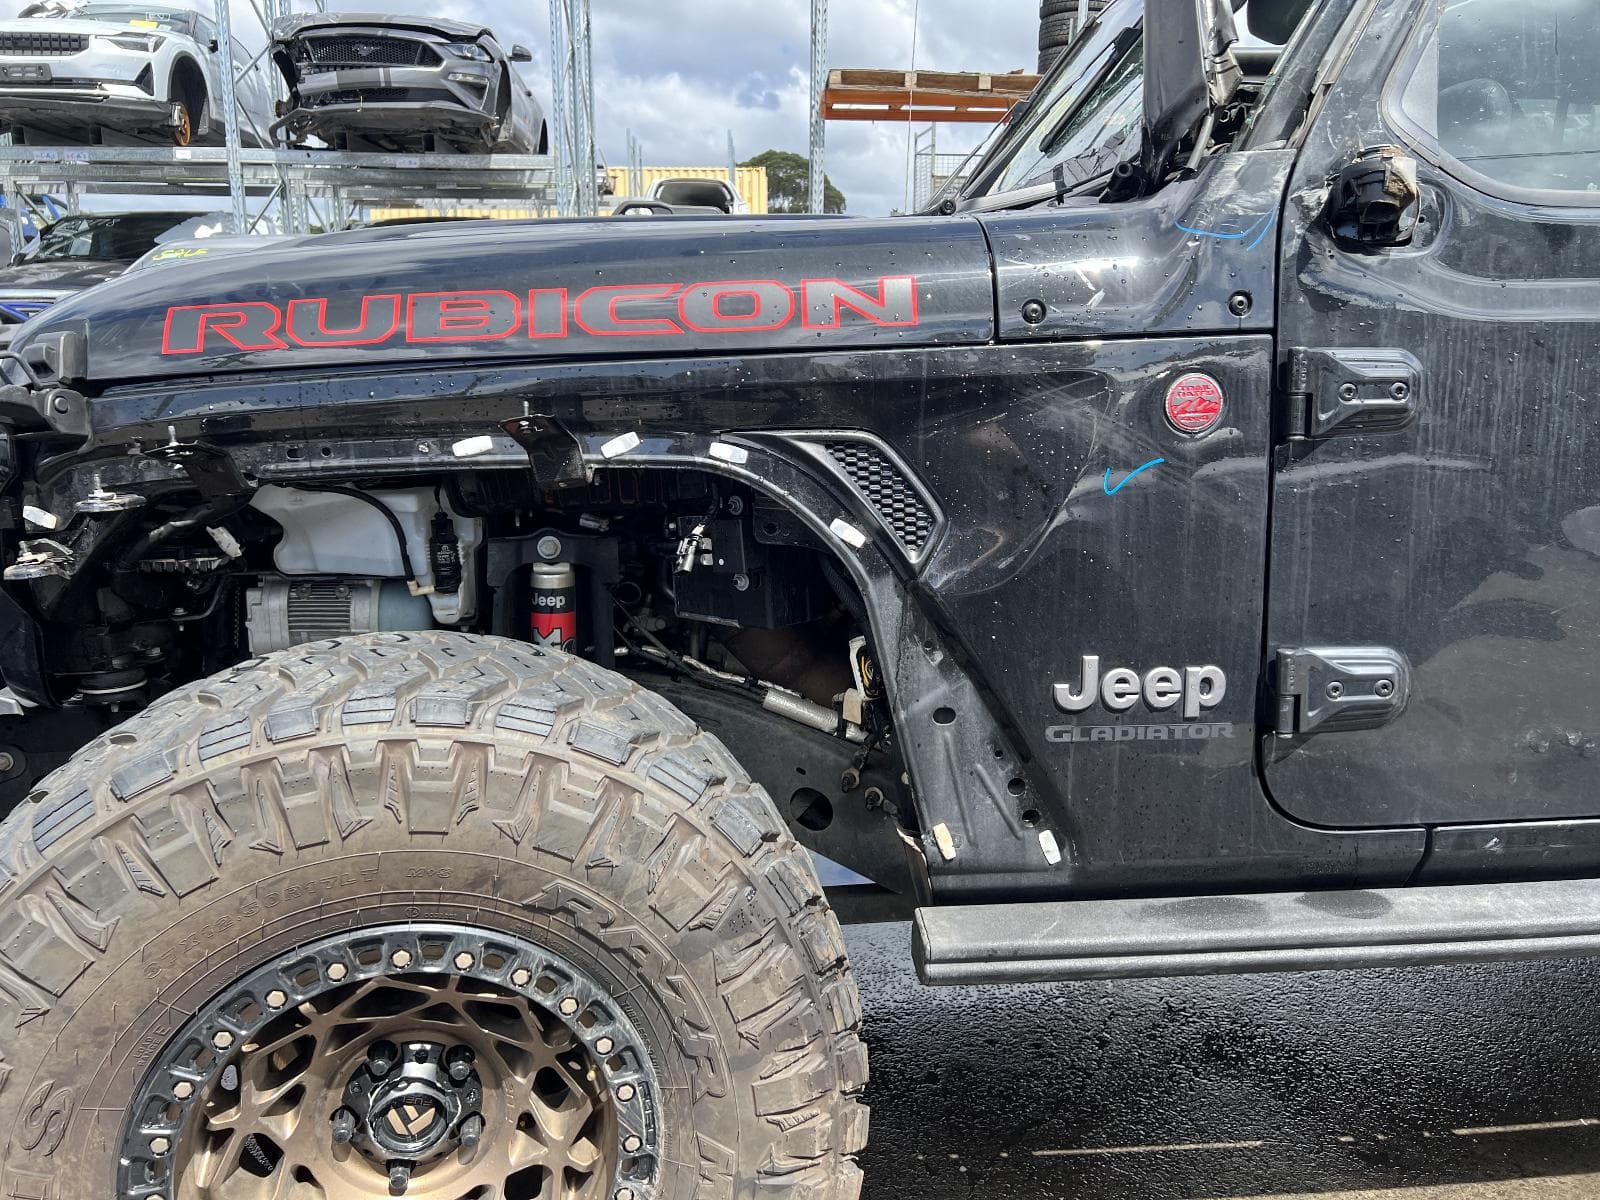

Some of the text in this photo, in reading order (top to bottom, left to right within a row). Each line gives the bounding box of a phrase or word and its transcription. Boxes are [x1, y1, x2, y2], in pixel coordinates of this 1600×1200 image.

[162, 275, 919, 355] RUBICON
[532, 593, 566, 609] Jeep
[1053, 655, 1227, 720] Jeep
[1044, 722, 1236, 743] GLADIATOR
